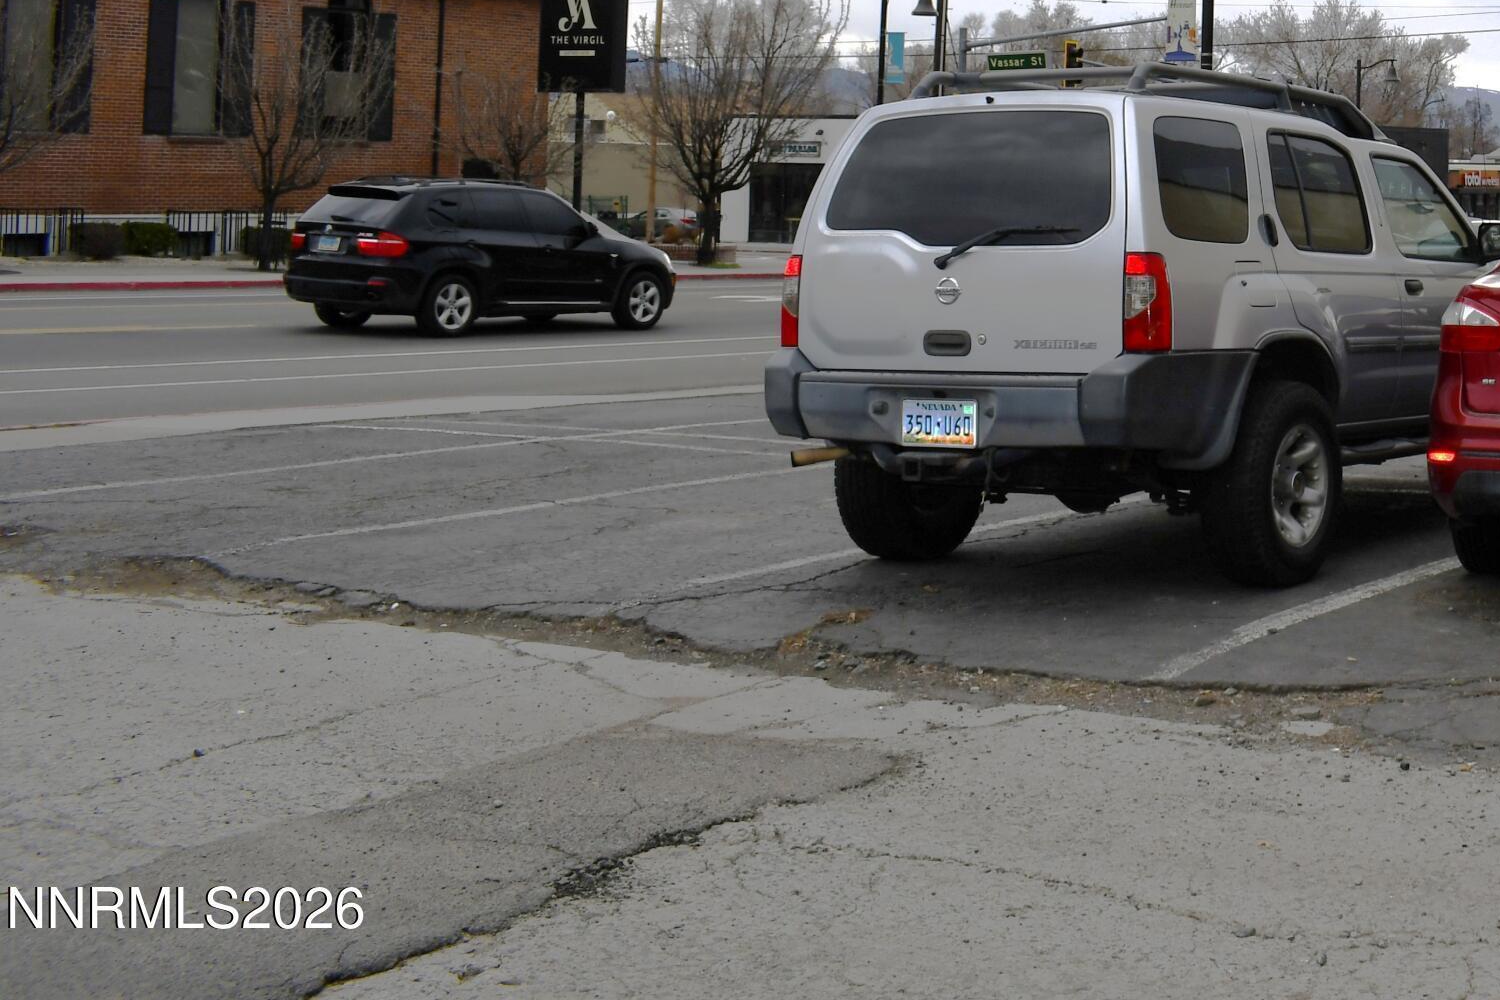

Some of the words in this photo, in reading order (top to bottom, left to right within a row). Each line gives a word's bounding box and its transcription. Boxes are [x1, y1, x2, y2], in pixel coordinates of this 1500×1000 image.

[551, 35, 569, 45] THE
[572, 35, 605, 45] VIRGIL
[990, 58, 1025, 68] Vassar
[1031, 56, 1043, 66] St
[1465, 170, 1481, 186] total
[921, 403, 957, 411] NEVADA
